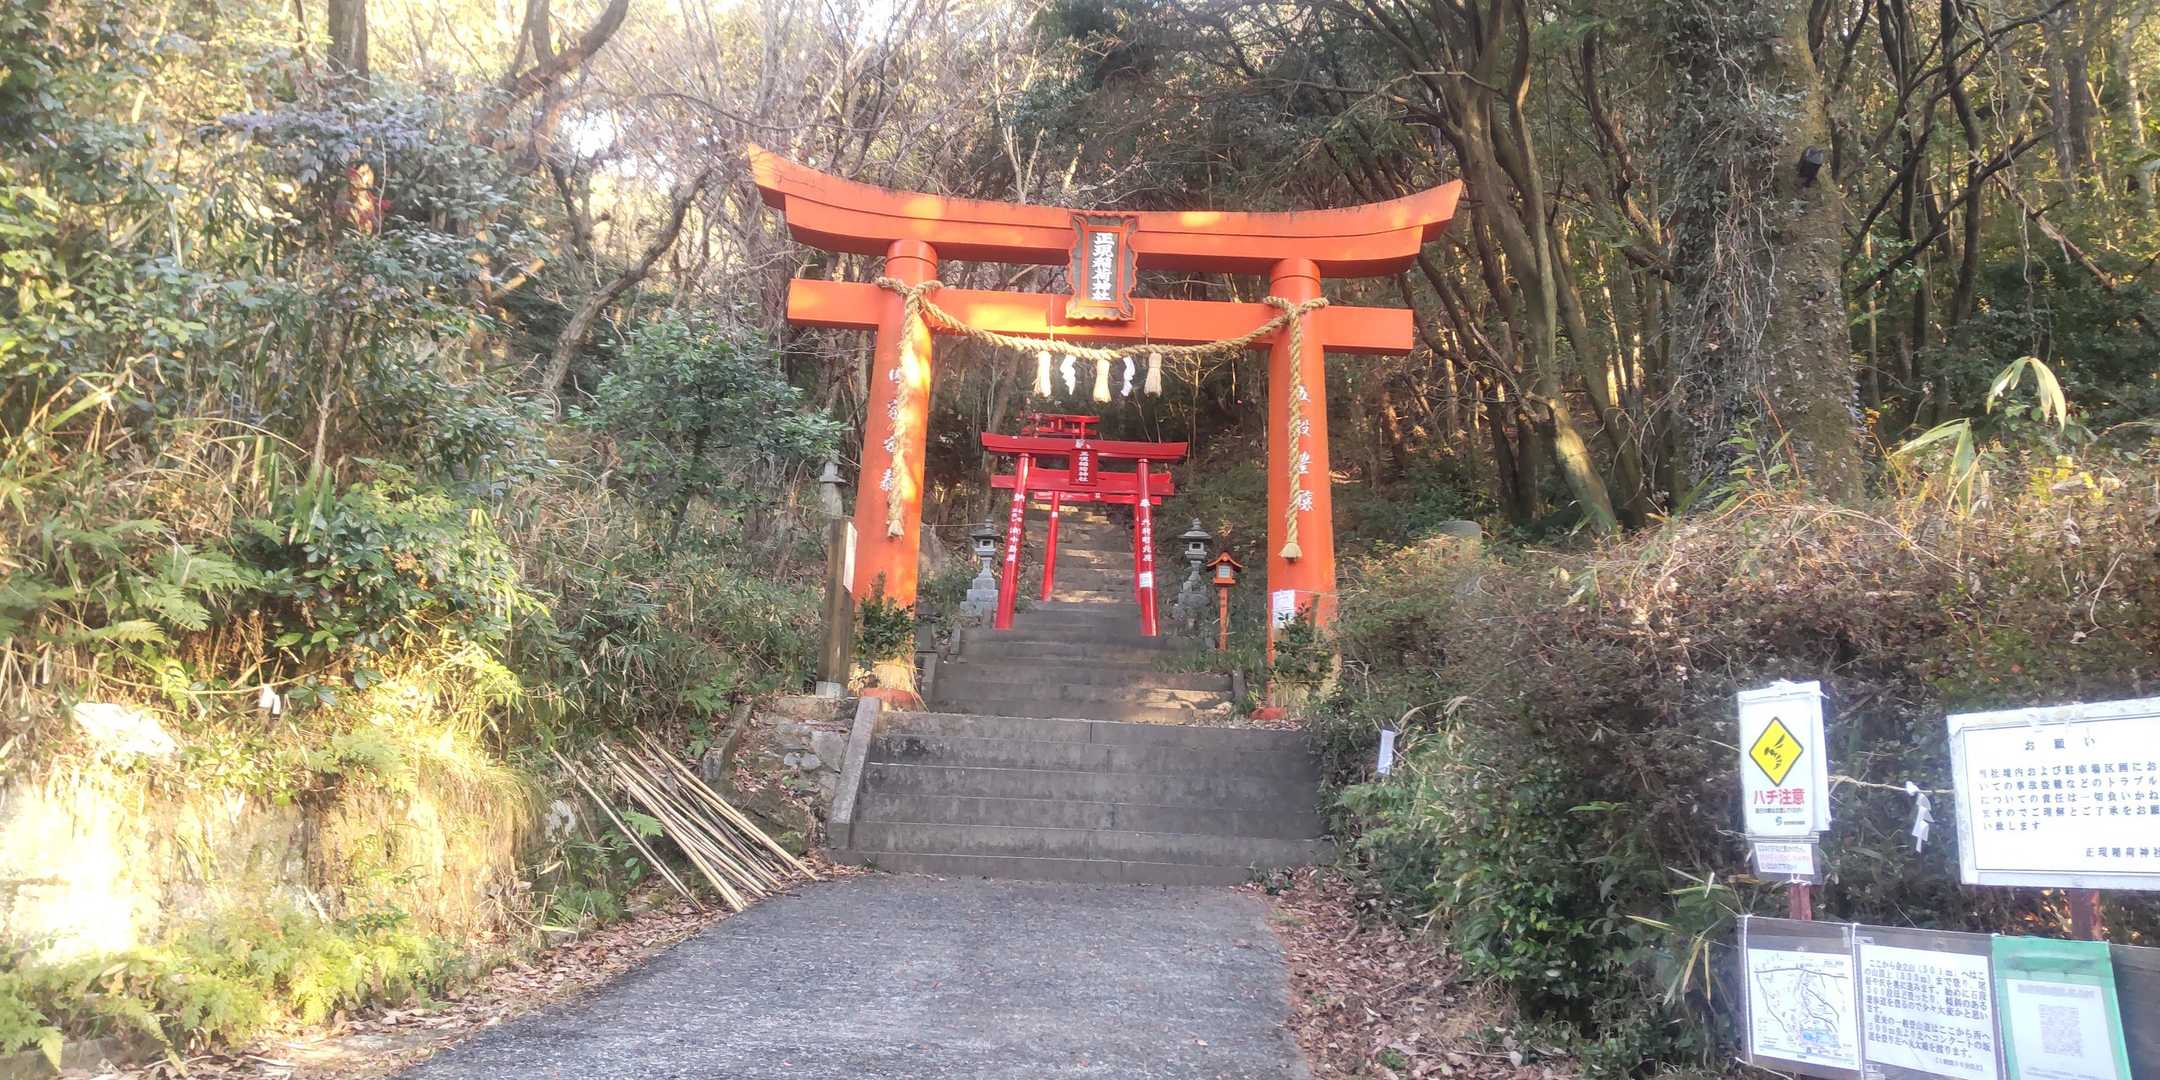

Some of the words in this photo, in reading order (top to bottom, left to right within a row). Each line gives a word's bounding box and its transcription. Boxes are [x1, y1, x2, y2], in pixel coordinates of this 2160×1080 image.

[2025, 737, 2096, 751] お願い
[1754, 788, 1805, 805] ハチ注意
[1984, 821, 2041, 831] い致します
